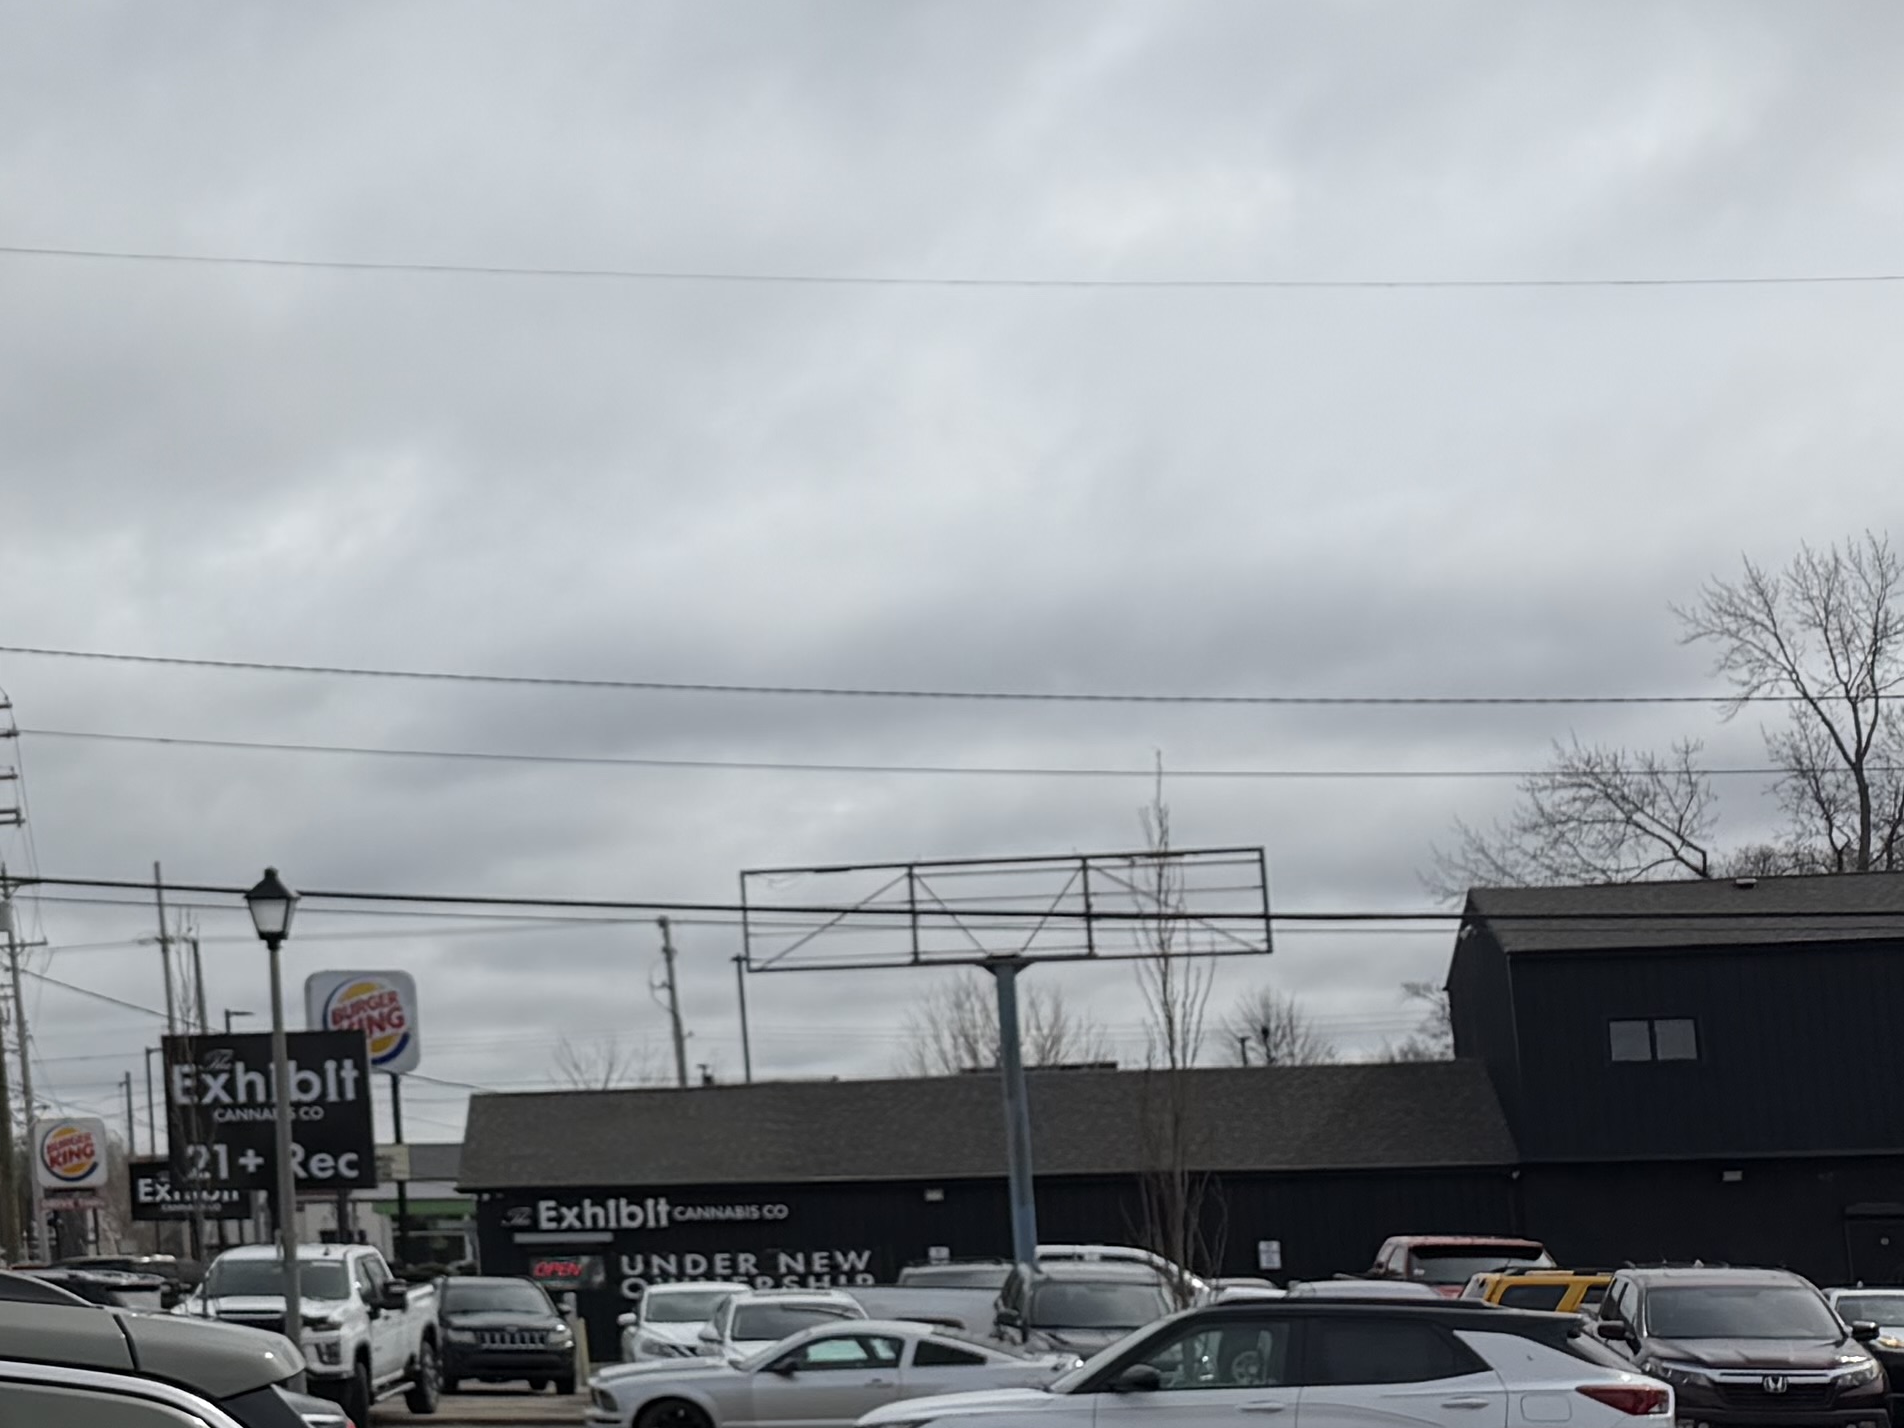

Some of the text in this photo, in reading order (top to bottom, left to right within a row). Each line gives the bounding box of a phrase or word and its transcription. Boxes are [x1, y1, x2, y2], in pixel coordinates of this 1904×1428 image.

[332, 990, 398, 1027] BURGER
[299, 1105, 325, 1120] CO
[50, 1142, 95, 1168] KING
[290, 1142, 360, 1180] Rec
[537, 1197, 671, 1230] Exhibit
[673, 1205, 760, 1221] CANNABIS
[762, 1204, 790, 1220] CO
[534, 1260, 582, 1277] OPEN
[620, 1249, 872, 1276] UNDER NEW
